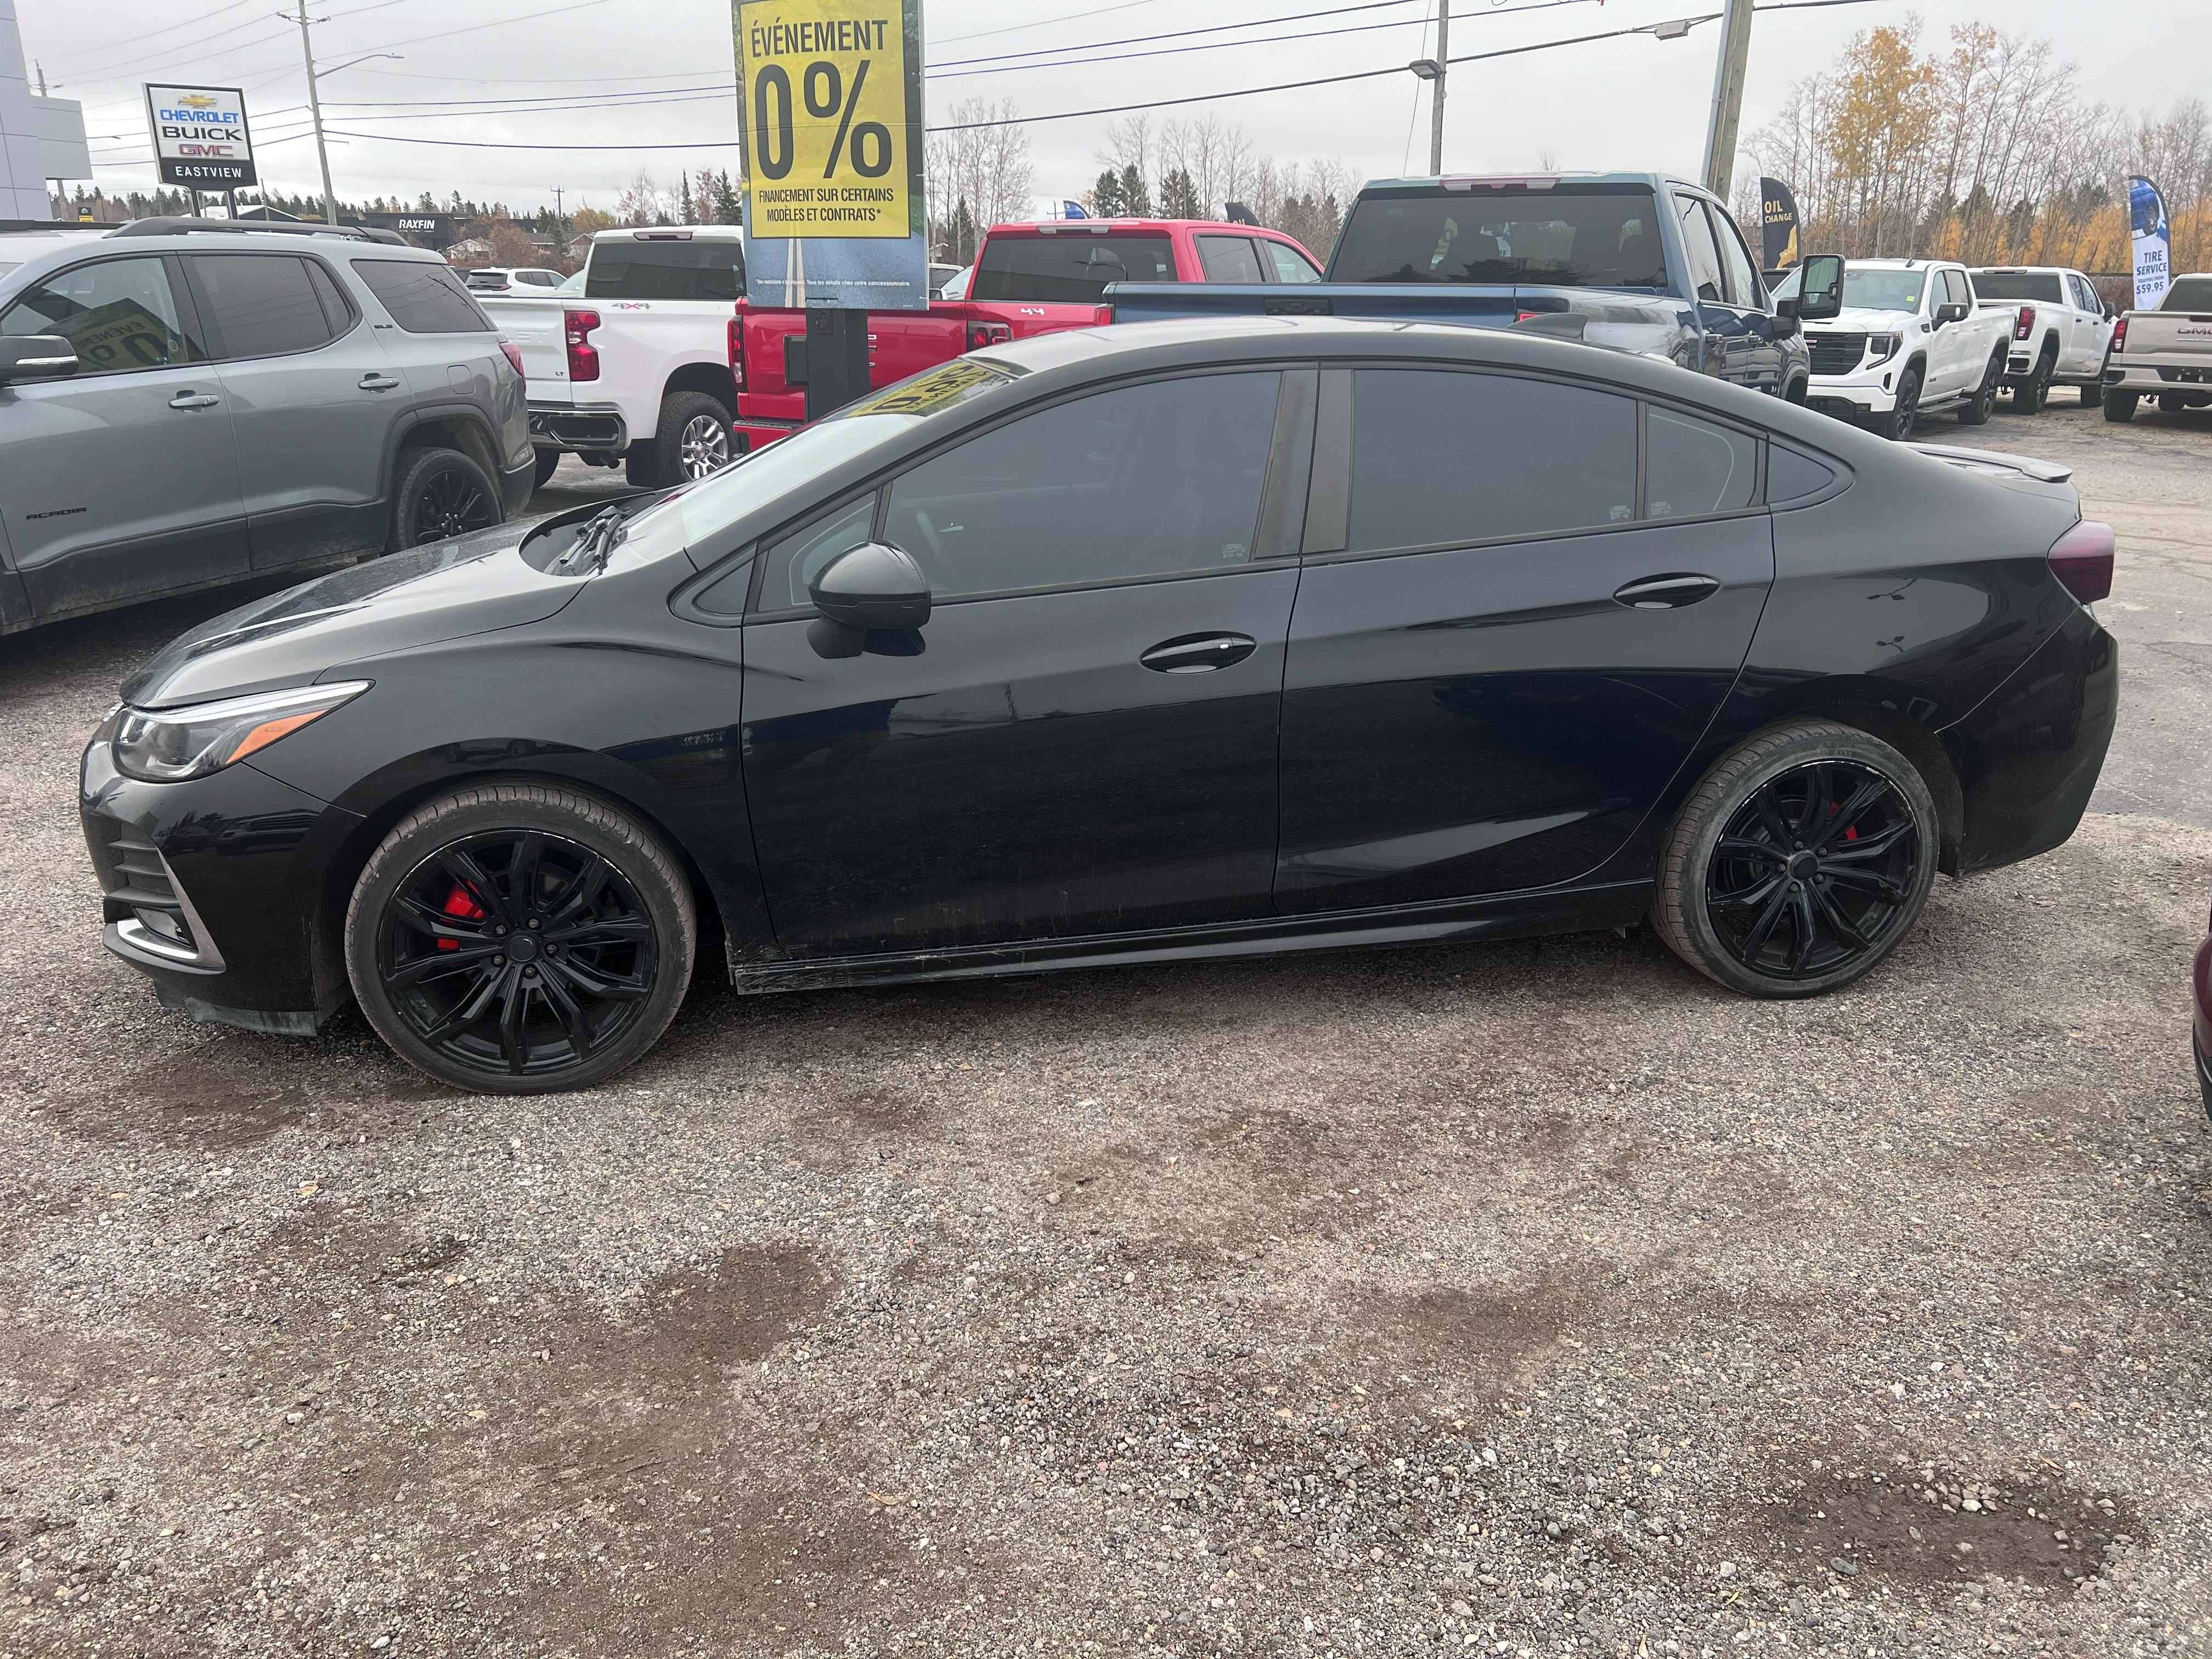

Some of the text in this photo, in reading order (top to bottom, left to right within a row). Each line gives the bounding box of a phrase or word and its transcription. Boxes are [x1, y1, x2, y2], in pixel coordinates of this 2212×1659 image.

[751, 16, 888, 57] ÉVÉNEMENT
[160, 109, 238, 123] CHEVROLET
[755, 59, 891, 180] 0%
[162, 126, 243, 140] BUICK
[178, 144, 234, 157] GMC
[175, 166, 241, 177] EASTVIEW
[759, 188, 894, 202] FINANCEMENT SUR CERTAINS
[1764, 200, 1782, 213] OIL
[767, 206, 804, 222] MODÈLES
[807, 208, 817, 221] ET
[1765, 213, 1792, 223] CHANGE
[399, 219, 435, 229] RAXFIN
[2144, 250, 2162, 263] TIRE
[2137, 262, 2167, 275] SERVICE
[2136, 281, 2163, 295] $59.95
[26, 507, 86, 520] ACADIA
